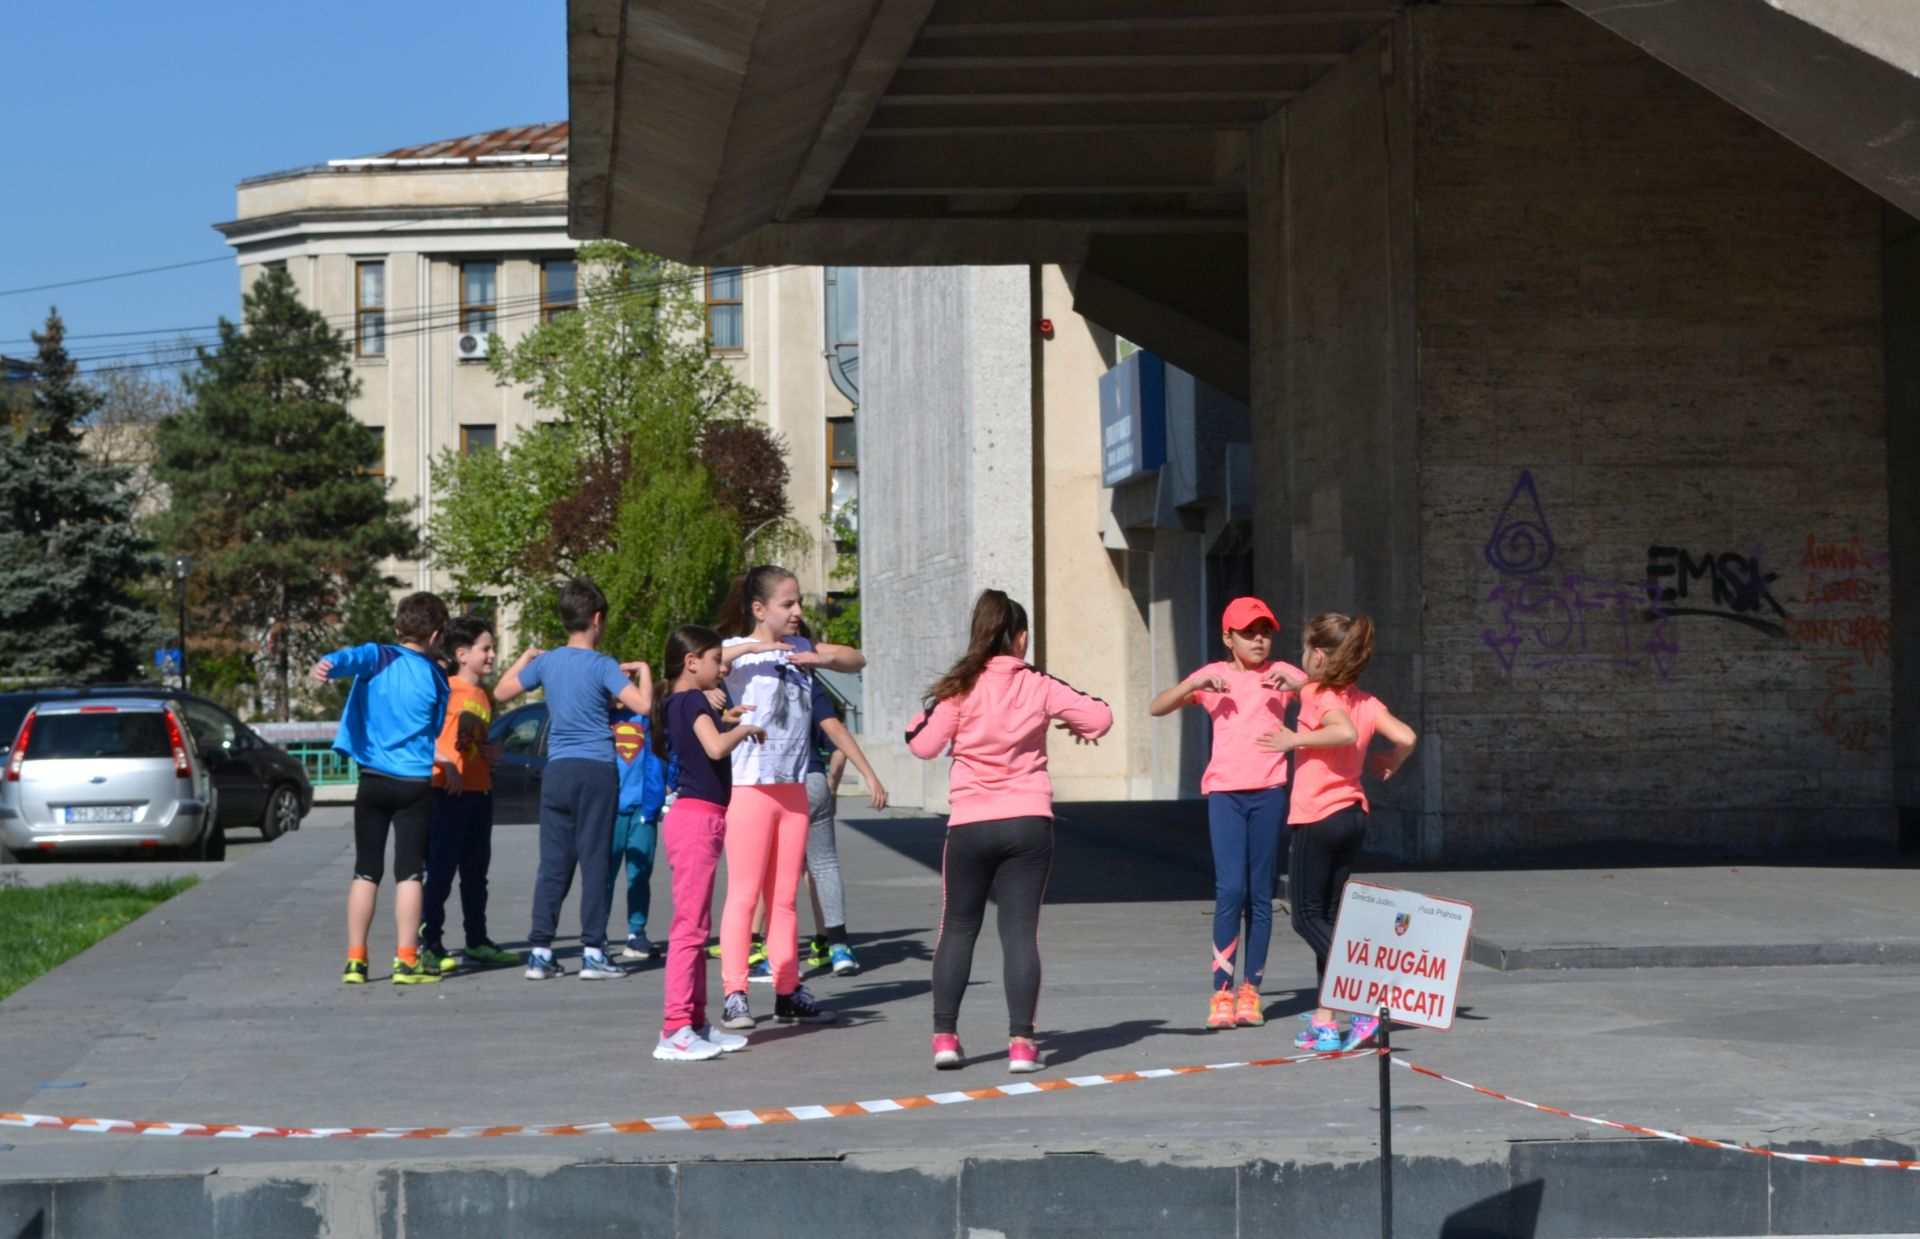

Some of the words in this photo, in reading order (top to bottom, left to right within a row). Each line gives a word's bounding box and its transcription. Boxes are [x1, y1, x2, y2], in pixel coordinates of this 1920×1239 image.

[1346, 936, 1369, 966] VĂ
[1374, 948, 1447, 981] RUGĂM
[1332, 975, 1363, 1001] NU
[1366, 981, 1445, 1021] PARCAȚI
